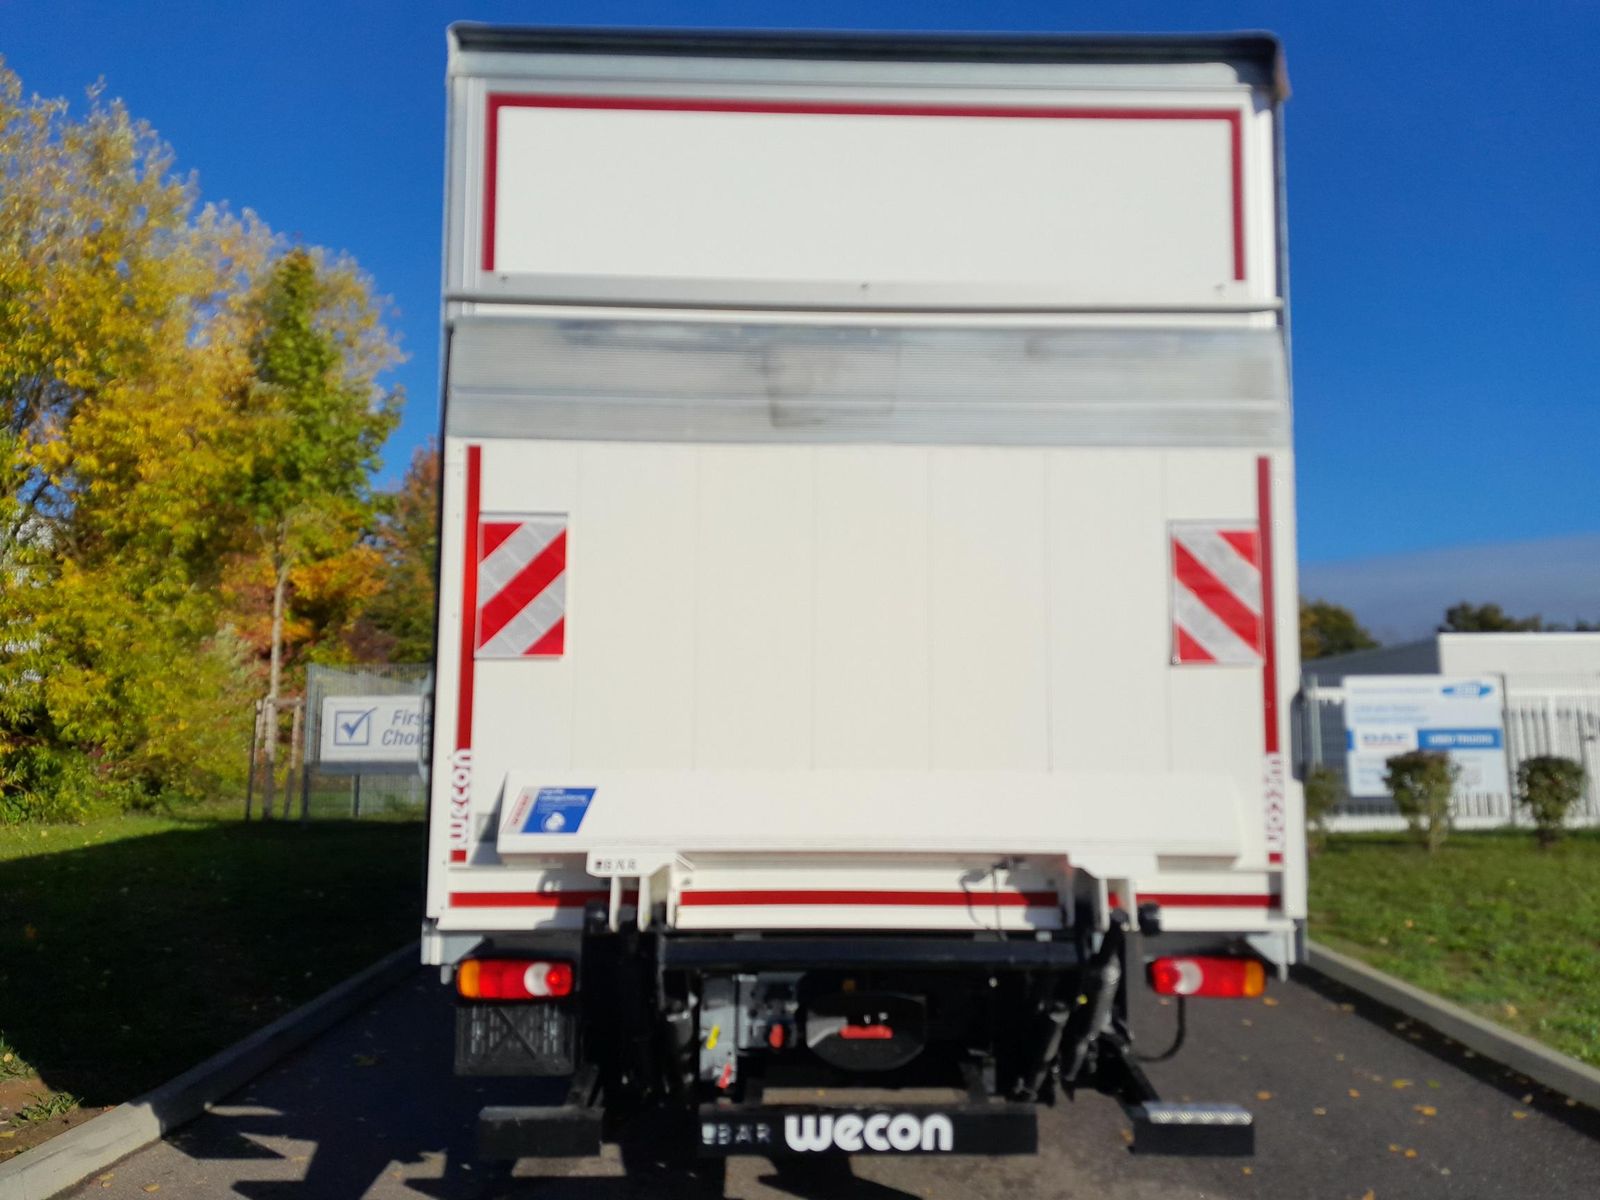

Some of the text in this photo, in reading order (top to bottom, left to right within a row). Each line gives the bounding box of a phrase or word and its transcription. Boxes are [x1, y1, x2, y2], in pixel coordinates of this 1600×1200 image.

[391, 709, 428, 726] Firs
[381, 728, 426, 746] Choi
[717, 1112, 954, 1153] BAR wecon
